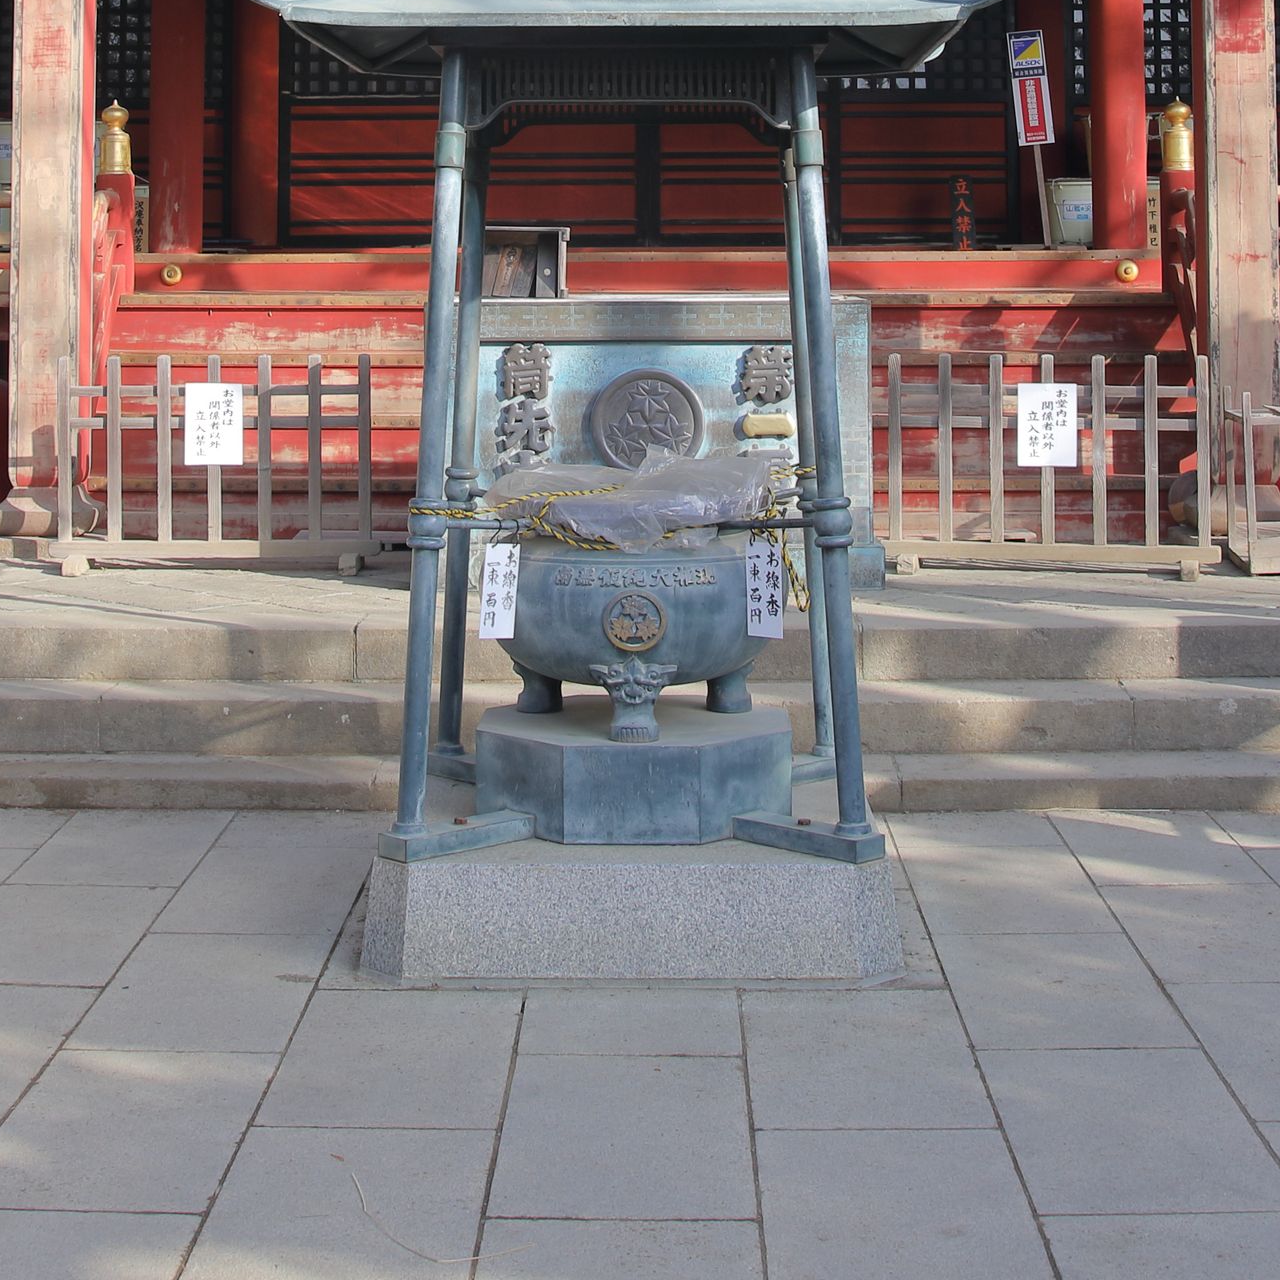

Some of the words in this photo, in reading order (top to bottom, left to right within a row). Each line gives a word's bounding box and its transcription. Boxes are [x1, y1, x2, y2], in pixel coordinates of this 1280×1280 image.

[1015, 59, 1041, 67] ALSOK
[954, 178, 972, 250] 立入禁止
[222, 389, 235, 425] お堂内は
[1041, 401, 1054, 450] 関係者以外
[1055, 389, 1068, 426] お堂内は
[195, 410, 207, 456] 立入禁止
[1027, 410, 1040, 457] 立入禁止
[502, 549, 518, 611] お線香
[766, 549, 781, 618] お線香
